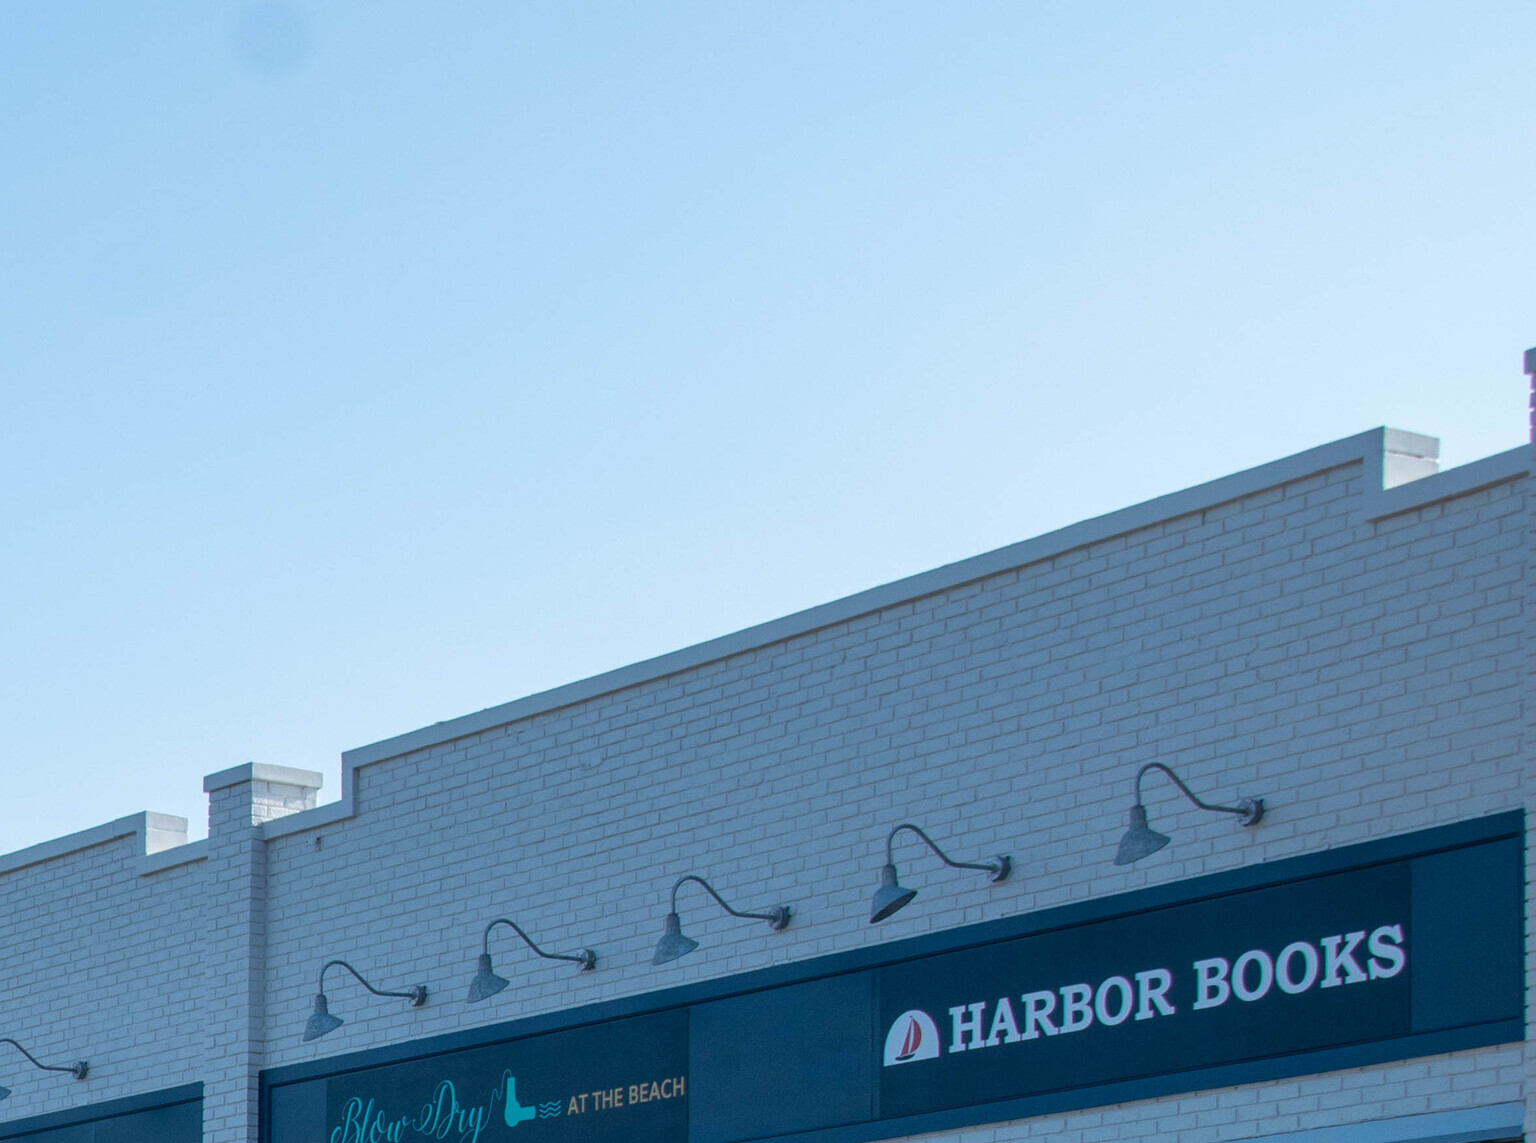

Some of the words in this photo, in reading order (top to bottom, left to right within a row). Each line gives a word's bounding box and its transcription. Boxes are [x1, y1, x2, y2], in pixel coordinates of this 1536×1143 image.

[948, 967, 1175, 1053] HARBOR
[1192, 922, 1406, 1010] BOOKS
[567, 1093, 590, 1116] AT
[592, 1087, 623, 1111] THE
[628, 1076, 686, 1105] BEACH
